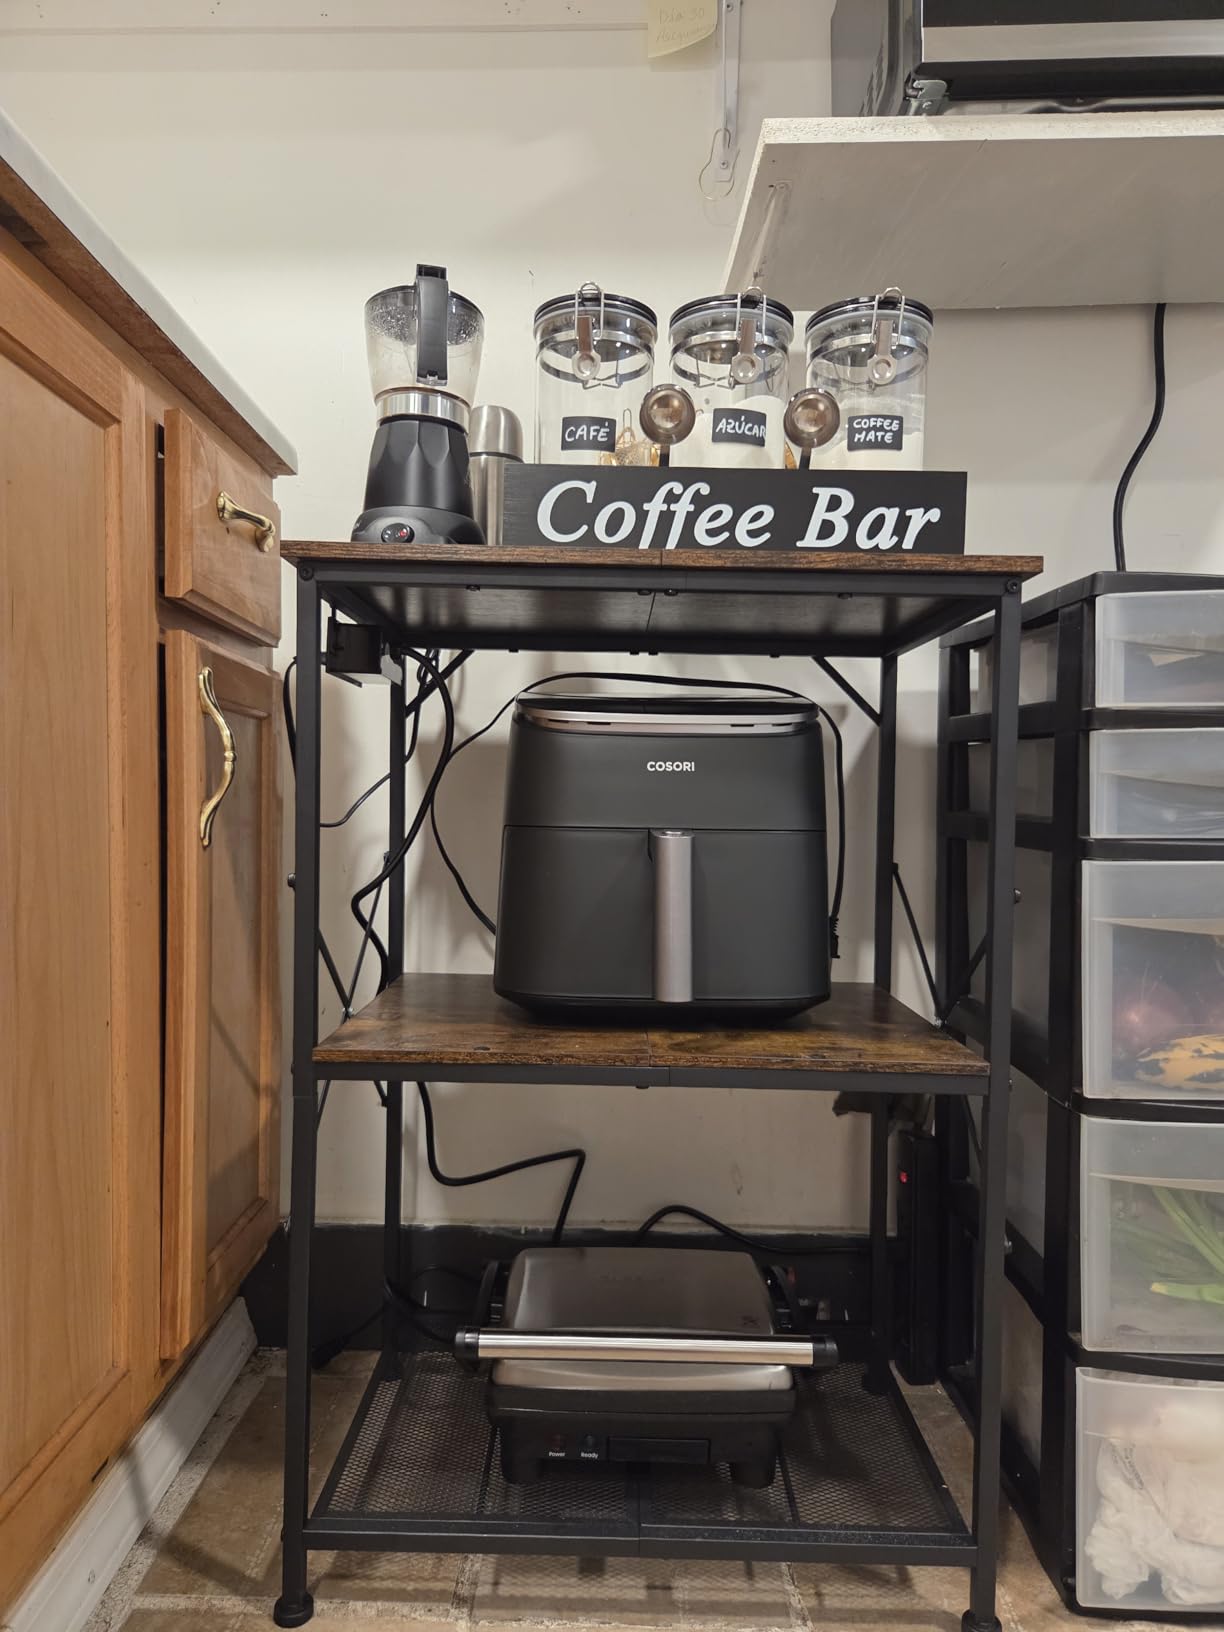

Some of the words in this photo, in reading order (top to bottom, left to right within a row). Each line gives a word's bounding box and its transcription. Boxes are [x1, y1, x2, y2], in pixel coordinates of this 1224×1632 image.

[715, 415, 767, 438] AZÚCAR
[853, 417, 900, 431] COFFEE
[564, 421, 610, 442] CAFÉ
[853, 430, 894, 444] MATE
[536, 480, 776, 550] Coffee
[796, 486, 941, 550] Bar
[646, 761, 696, 772] COSORI
[580, 1451, 599, 1460] Ready
